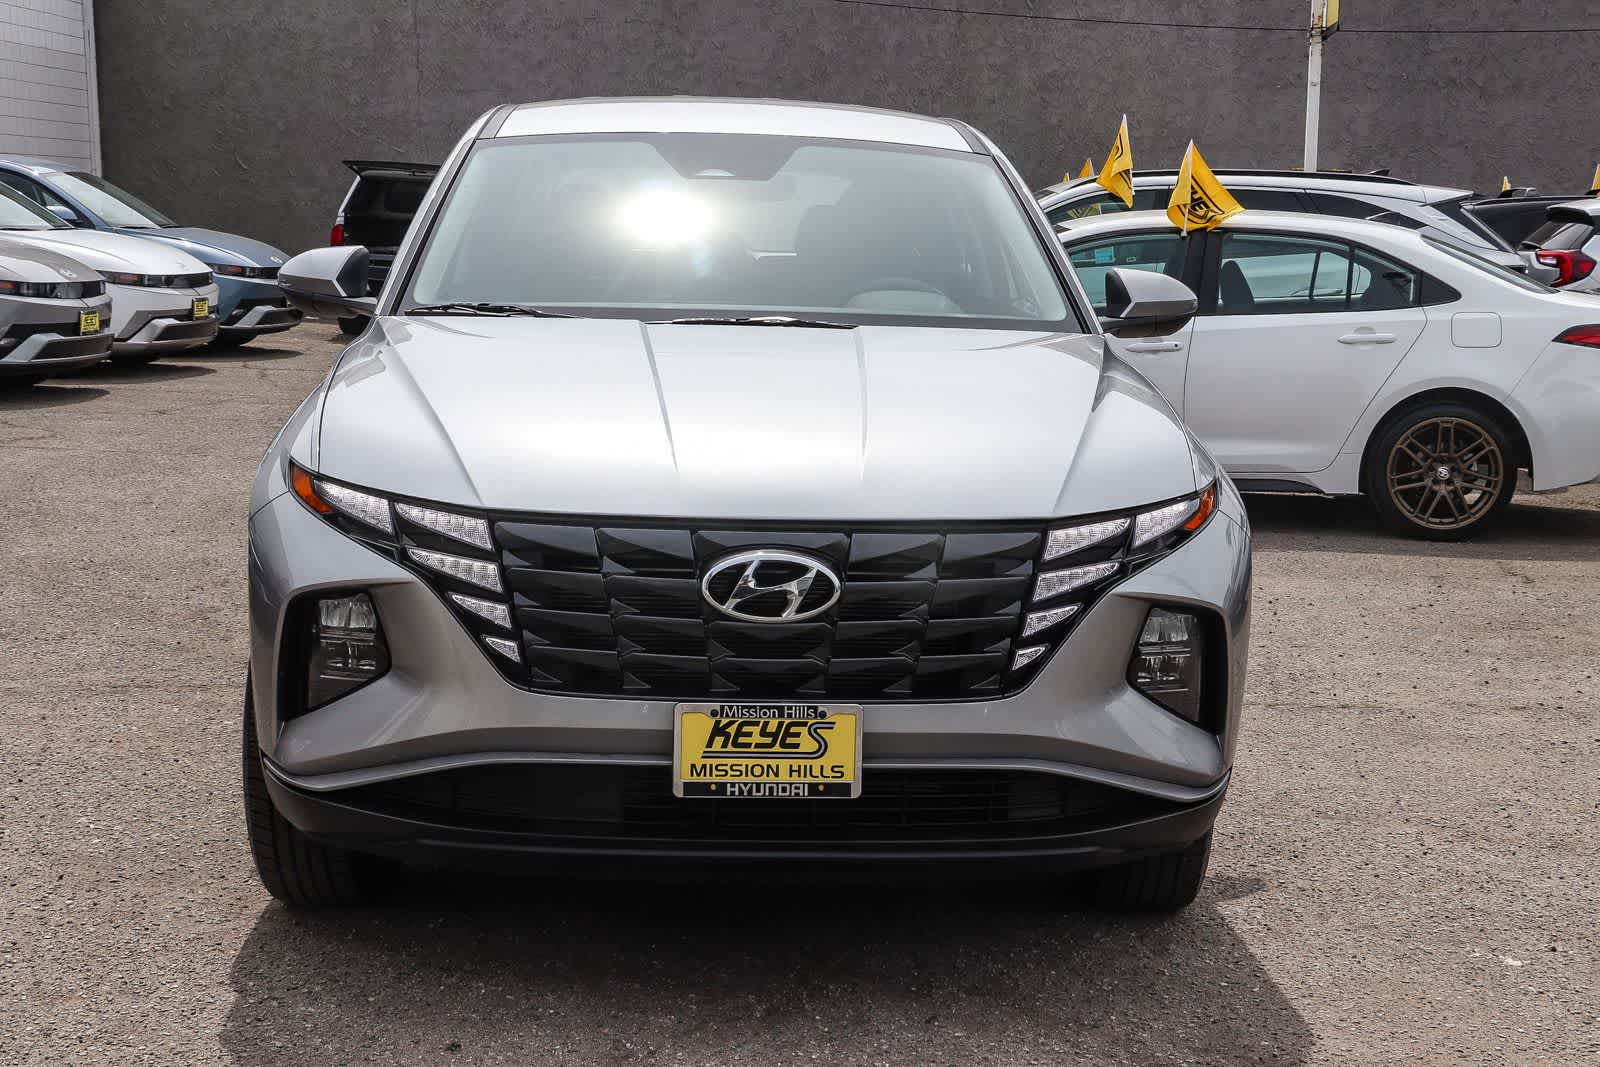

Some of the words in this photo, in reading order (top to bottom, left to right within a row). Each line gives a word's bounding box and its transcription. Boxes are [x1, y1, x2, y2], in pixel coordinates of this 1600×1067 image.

[722, 705, 779, 718] Mission
[784, 706, 816, 719] Hills
[701, 719, 836, 760] KEYES
[690, 763, 780, 778] MISSION
[789, 764, 845, 779] HILLS
[726, 783, 808, 797] HYUNDAI
